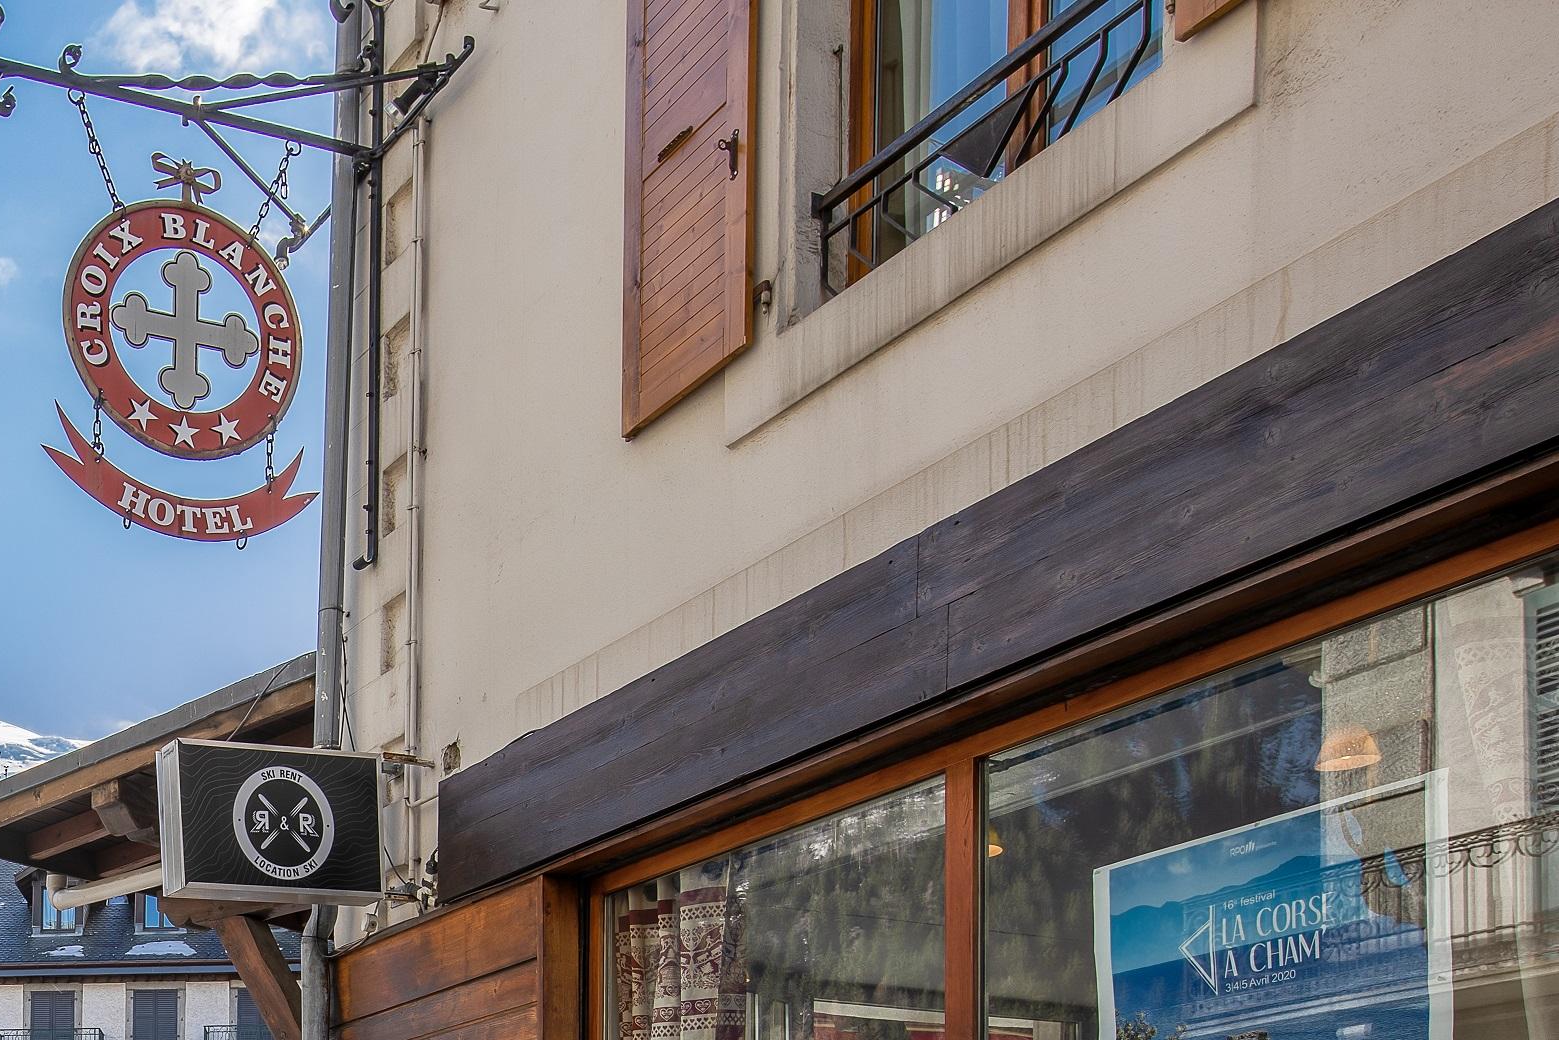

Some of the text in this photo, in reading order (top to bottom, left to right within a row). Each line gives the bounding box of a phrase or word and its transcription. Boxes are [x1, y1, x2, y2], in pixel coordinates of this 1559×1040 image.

[79, 212, 293, 404] CROIX BLANCHE
[117, 481, 253, 535] HOTEL
[260, 769, 303, 783] SKI RENT
[279, 816, 290, 831] &
[299, 812, 320, 837] R
[254, 856, 320, 878] LOCATION SKI
[1240, 889, 1276, 908] festival
[1221, 891, 1335, 946] LA CORSE
[1224, 924, 1328, 979] À CHAM'
[1249, 975, 1270, 988] Avril
[1271, 969, 1297, 983] 2020
